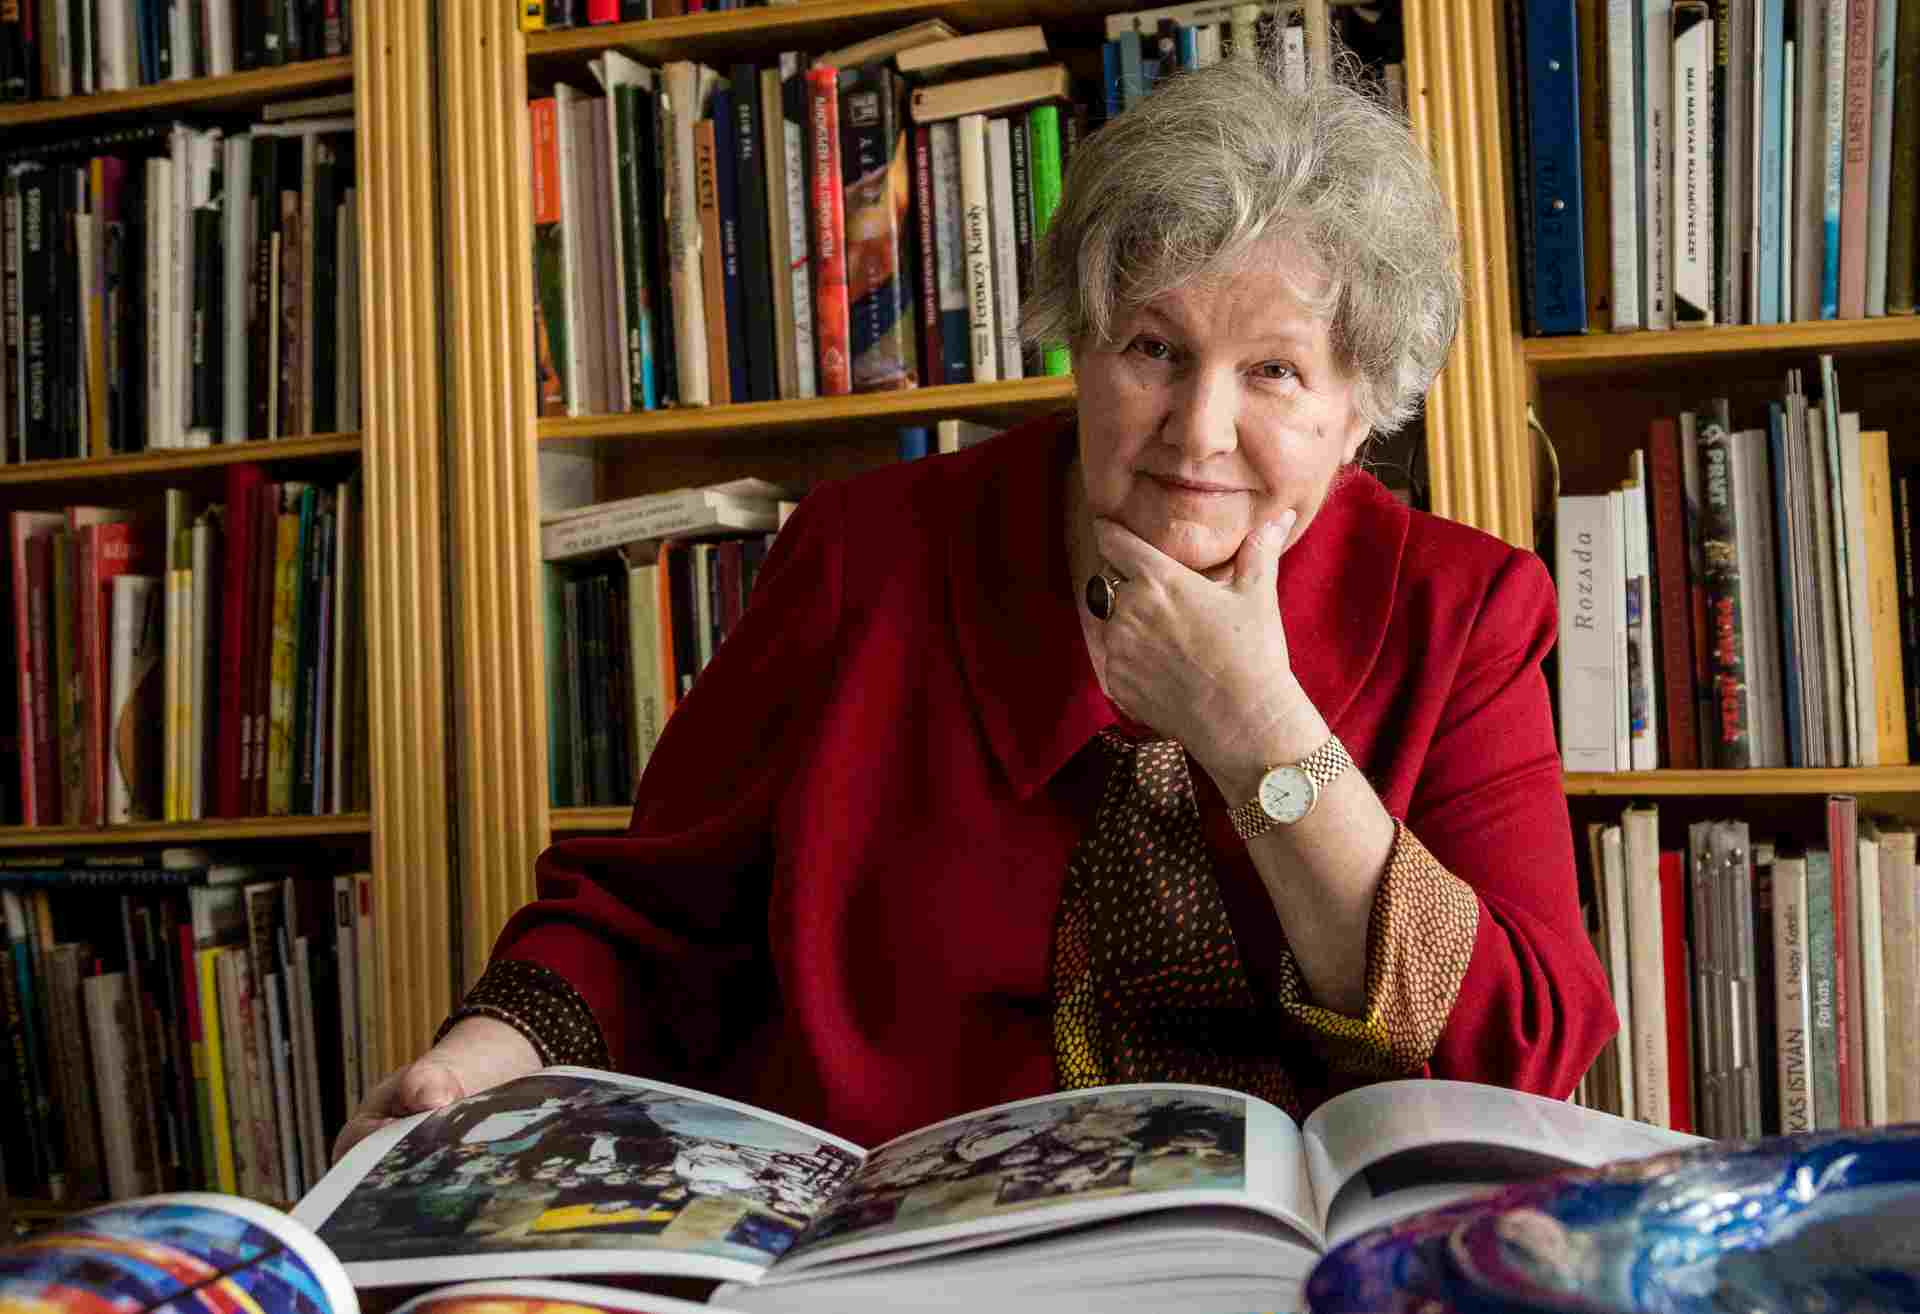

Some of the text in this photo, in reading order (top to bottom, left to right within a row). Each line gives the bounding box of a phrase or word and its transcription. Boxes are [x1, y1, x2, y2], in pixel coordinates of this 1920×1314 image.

[1686, 97, 1696, 154] MAGYAR
[968, 204, 986, 255] Károly
[972, 260, 989, 329] Ferenczy
[1573, 531, 1594, 632] Rozsda
[1786, 1029, 1806, 1091] ISTVÁN
[1788, 1097, 1807, 1135] KAS
